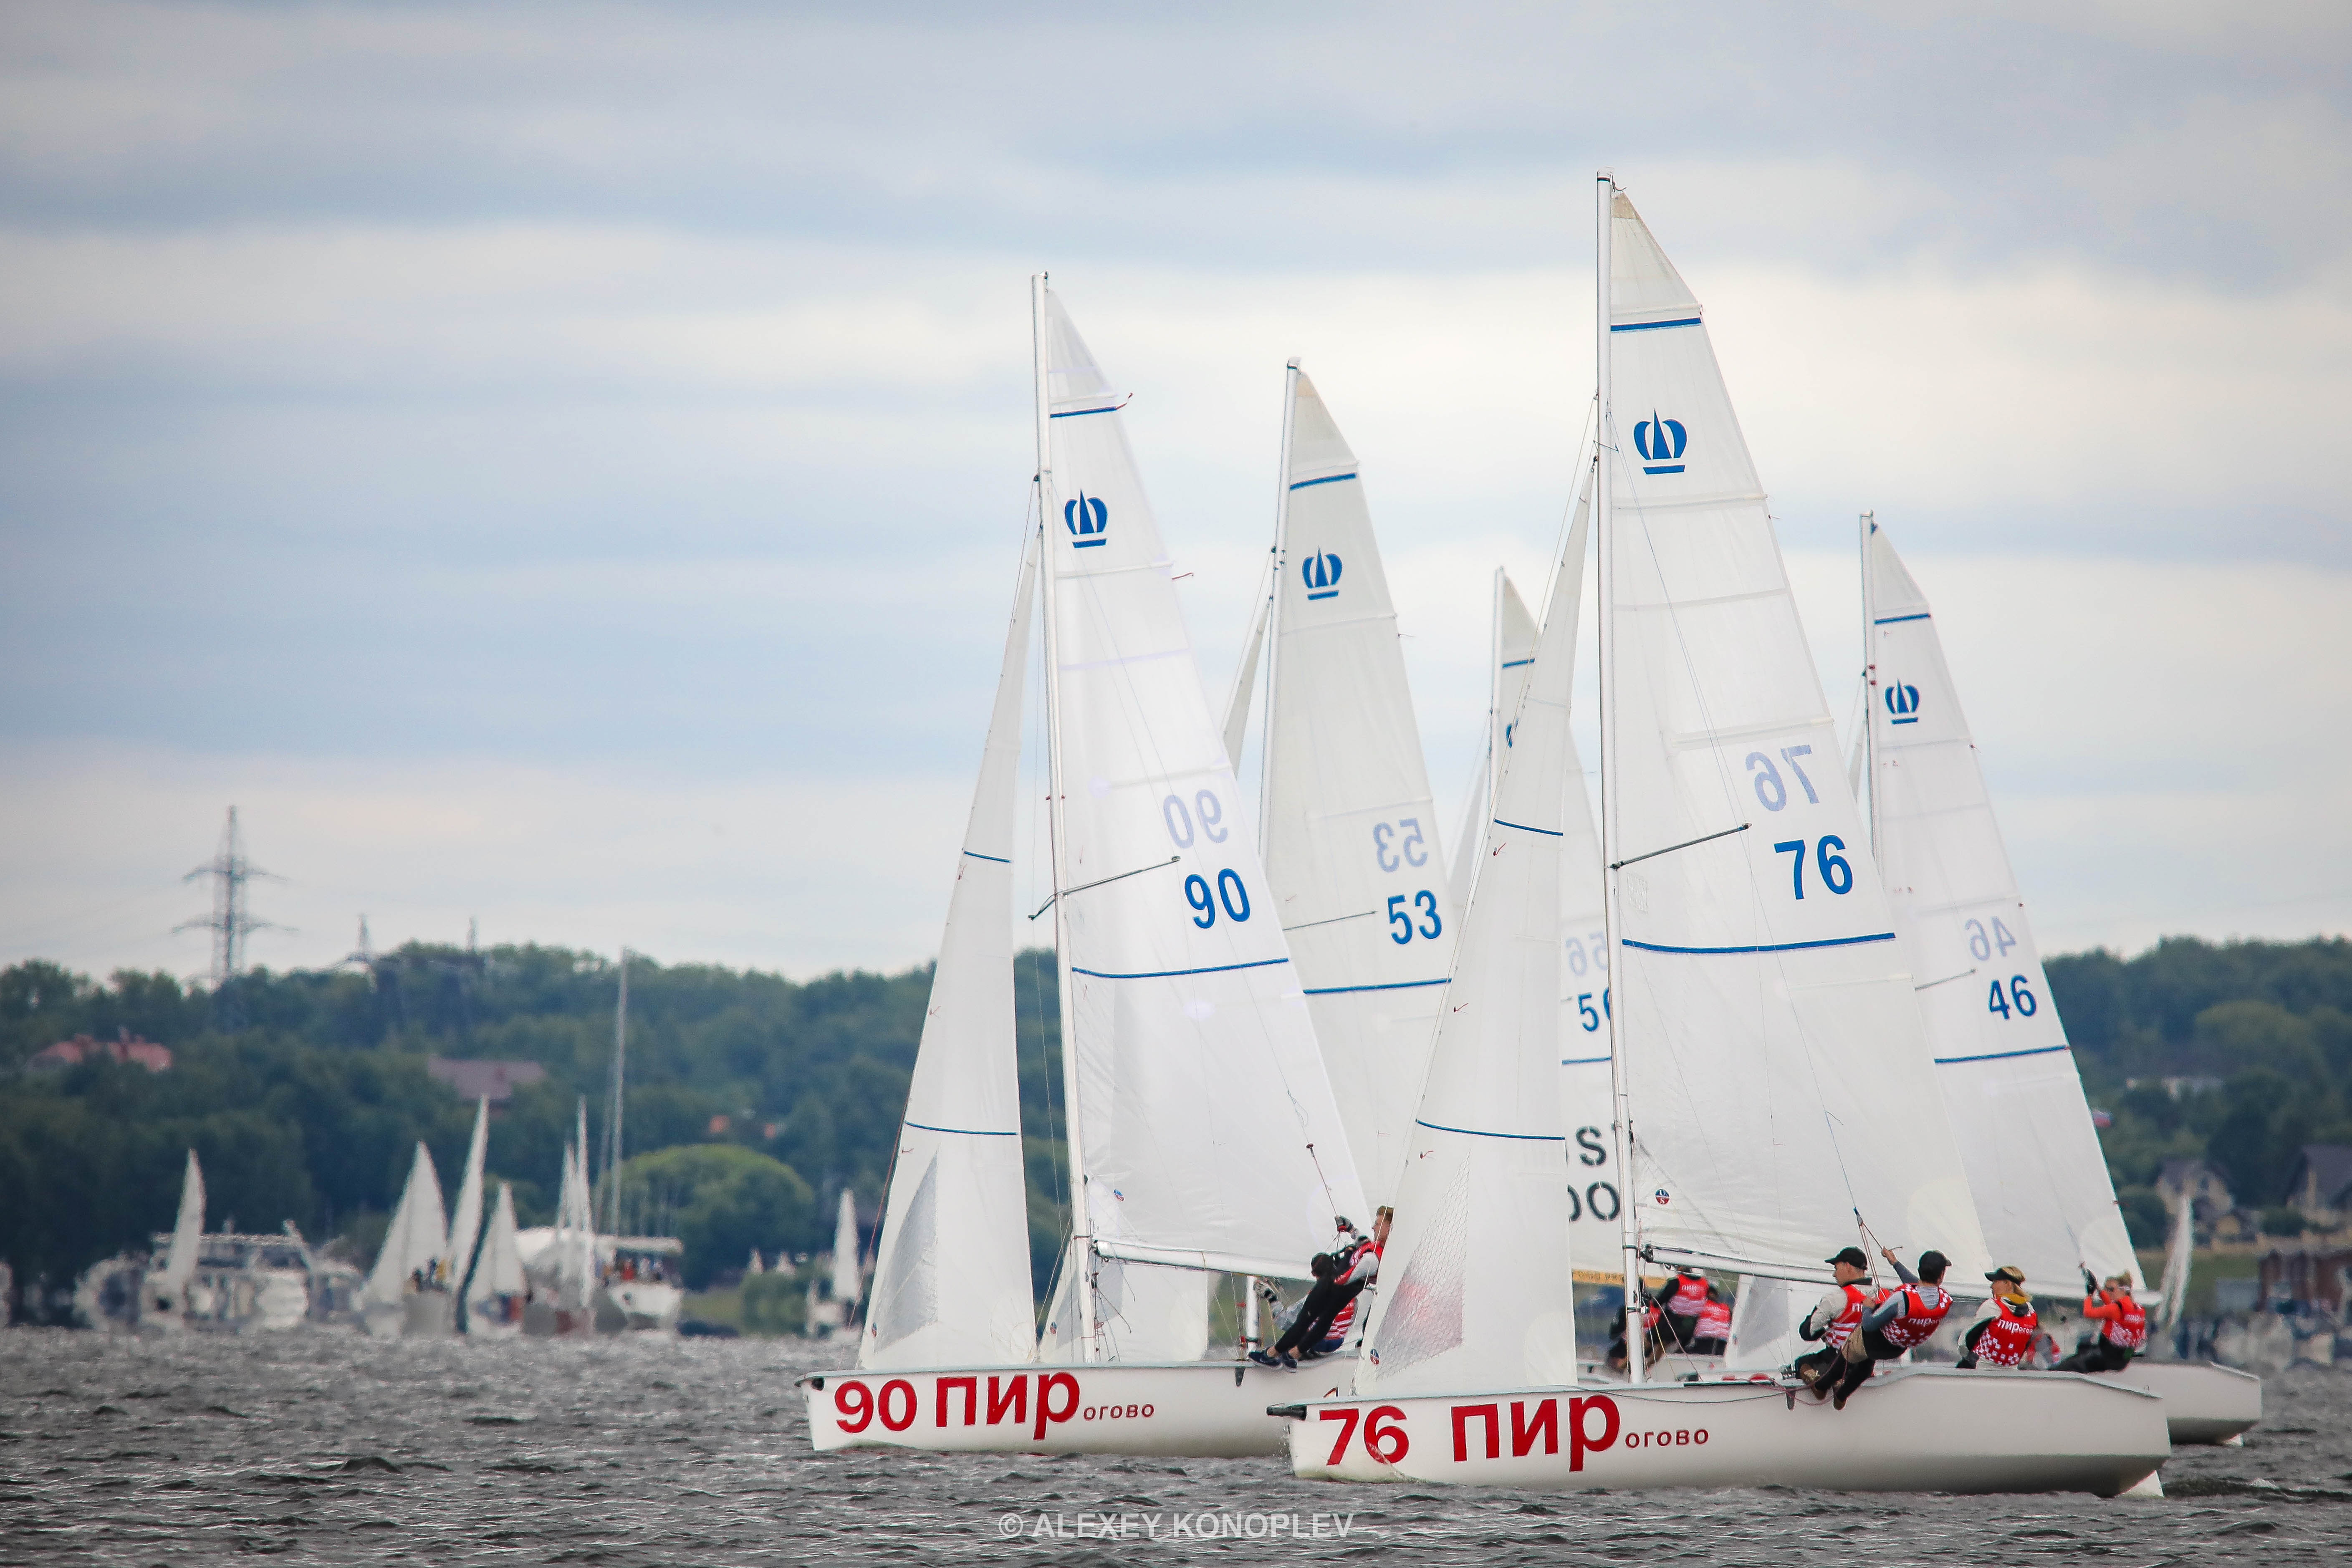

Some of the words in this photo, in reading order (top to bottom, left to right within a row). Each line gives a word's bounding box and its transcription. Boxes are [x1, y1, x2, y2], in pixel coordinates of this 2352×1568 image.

[1773, 835, 1853, 900] 76
[1185, 869, 1251, 929] 90
[1387, 890, 1442, 945] 53
[1988, 975, 2036, 1020] 46
[834, 1378, 918, 1435] 90
[1319, 1405, 1410, 1467] 76
